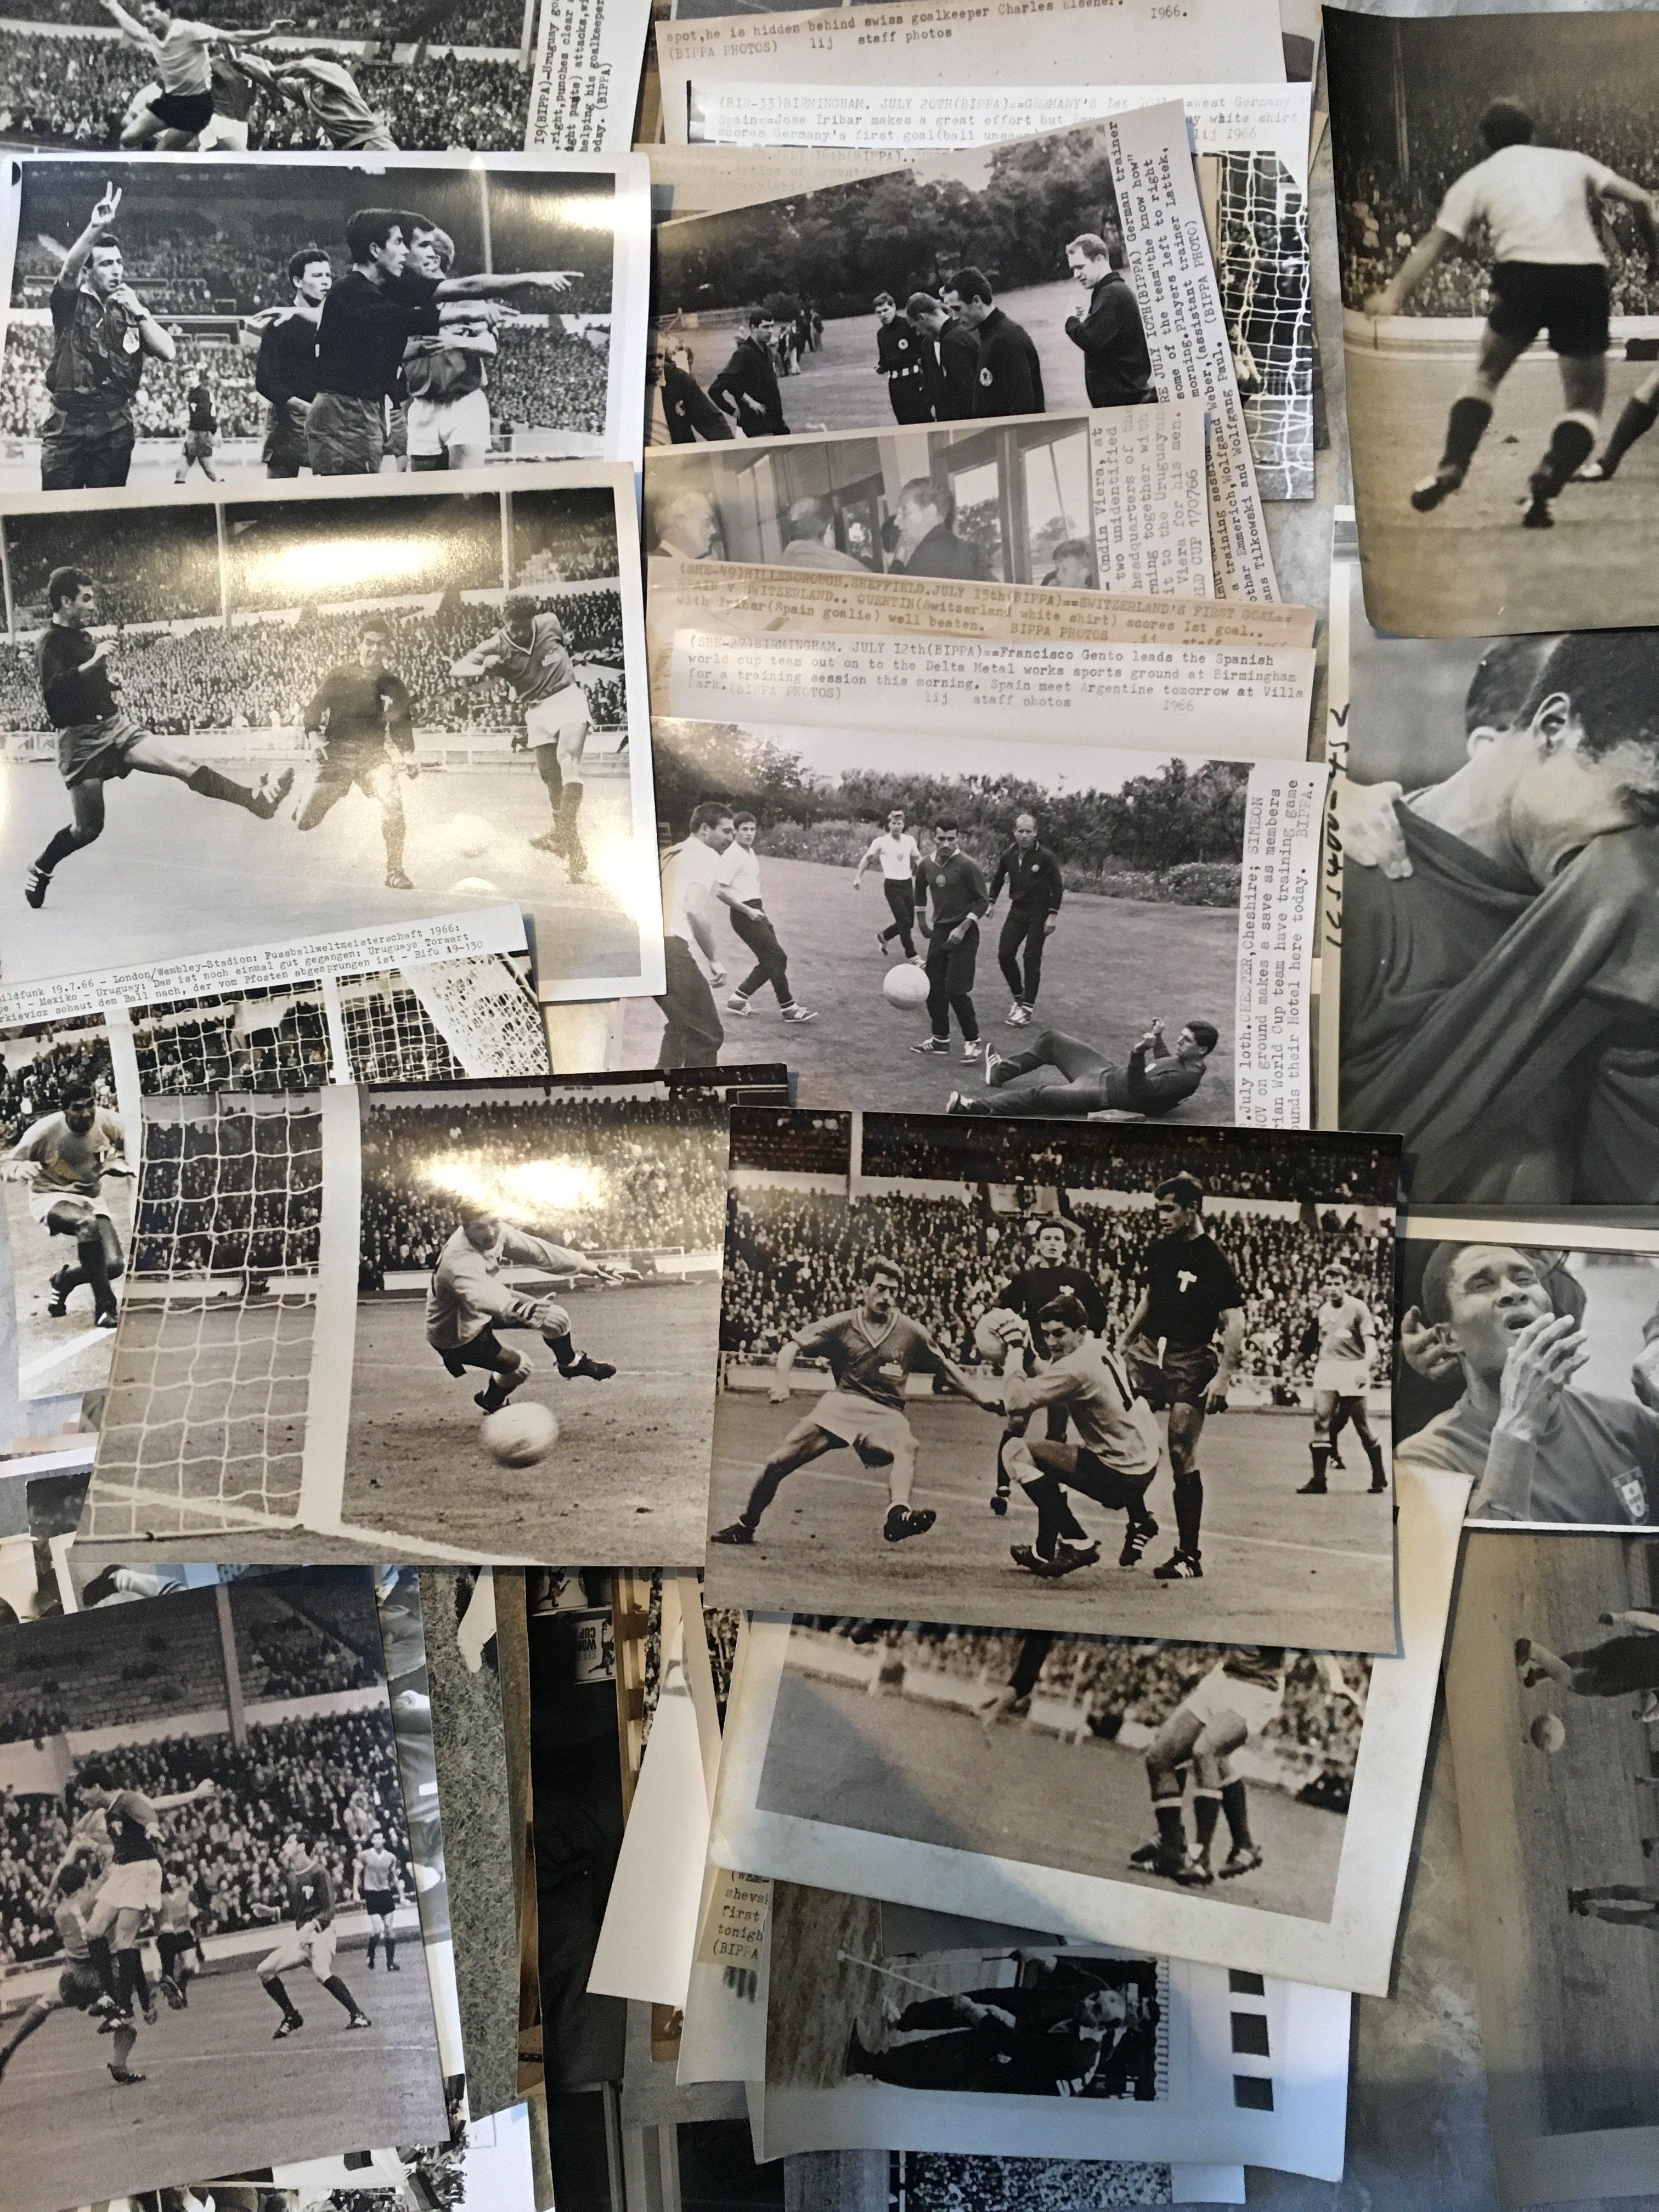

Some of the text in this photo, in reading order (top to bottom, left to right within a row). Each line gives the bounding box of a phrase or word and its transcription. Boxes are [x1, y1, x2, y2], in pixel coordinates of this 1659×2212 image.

[561, 10, 573, 45] clear
[669, 27, 952, 60] (BIPPA staff photos
[730, 27, 745, 38] is
[753, 24, 799, 36] hidden
[809, 18, 855, 32] behind
[865, 15, 904, 26] swiss
[912, 8, 989, 25] goalkeeper
[584, 76, 595, 96] his
[594, 63, 612, 109] (BIPPA)
[579, 104, 594, 152] helping
[718, 128, 894, 141] scores Germany's first
[816, 112, 862, 124] Iribar
[871, 115, 911, 125] makes
[935, 115, 975, 127] great
[984, 115, 1031, 125] effort
[1041, 114, 1062, 125] but
[1210, 113, 1249, 123] white
[1143, 159, 1159, 202] right
[1155, 210, 1164, 226] to
[1159, 148, 1189, 270] trainer Lattek,
[1109, 121, 1165, 379] JULY German trainer
[1158, 235, 1172, 267] left
[1136, 196, 1184, 399] some of the know
[1092, 428, 1103, 447] at
[1198, 275, 1265, 570] Tilkowski and Wolfgang Paul. (BIPPA
[1137, 414, 1155, 540] together with
[1186, 469, 1201, 527] 170766
[1105, 427, 1125, 580] two unidentified
[1122, 445, 1143, 589] headquarters of
[1170, 462, 1188, 584] Viera for his
[1158, 512, 1172, 566] to the
[1190, 537, 1202, 565] CUP
[1216, 510, 1235, 574] training
[823, 608, 1051, 636] goalie) well beaten. BIPPA
[1020, 609, 1174, 630] white shirt) scores
[1193, 605, 1234, 619] FIRST
[689, 654, 1296, 684] world cup team out on to the Delta Metal works sports ground at Birmingham
[1081, 649, 1274, 667] Gento leads the Spanish
[689, 668, 711, 678] for
[737, 669, 802, 685] training
[811, 673, 867, 685] session
[878, 675, 907, 686] this
[990, 679, 1031, 692] Spain
[1039, 682, 1071, 691] meet
[1080, 683, 1153, 696] Argentine
[1164, 685, 1229, 697] tomorrow
[1237, 688, 1254, 697] at
[1263, 686, 1304, 698] Villa
[973, 693, 1071, 707] staff photos
[1247, 797, 1262, 855] SIMEON
[1255, 789, 1280, 1096] on ground makes a save as members
[1271, 780, 1297, 1088] World Cup team have training game
[1287, 782, 1314, 1079] their Hotel here today. BIPPA.
[40, 994, 77, 1006] Mexiko
[153, 978, 171, 988] Das
[178, 974, 197, 984] ist
[204, 970, 228, 980] noch
[236, 963, 274, 975] einmal
[280, 960, 298, 970] gut
[305, 950, 361, 967] gegangen:
[368, 942, 417, 954] Uruguays
[425, 933, 469, 946] Torwart
[52, 979, 94, 994] 19.7.66
[430, 924, 459, 935] 1966:
[55, 1001, 93, 1013] schaut
[99, 998, 117, 1007] dem
[125, 993, 149, 1003] Ball
[155, 987, 186, 998] nach,
[193, 983, 211, 991] der
[245, 971, 288, 984] Pfosten
[295, 960, 370, 977] abgesprungen
[377, 956, 395, 964] ist
[415, 948, 439, 958] Bifu
[723, 1905, 760, 1922] first
